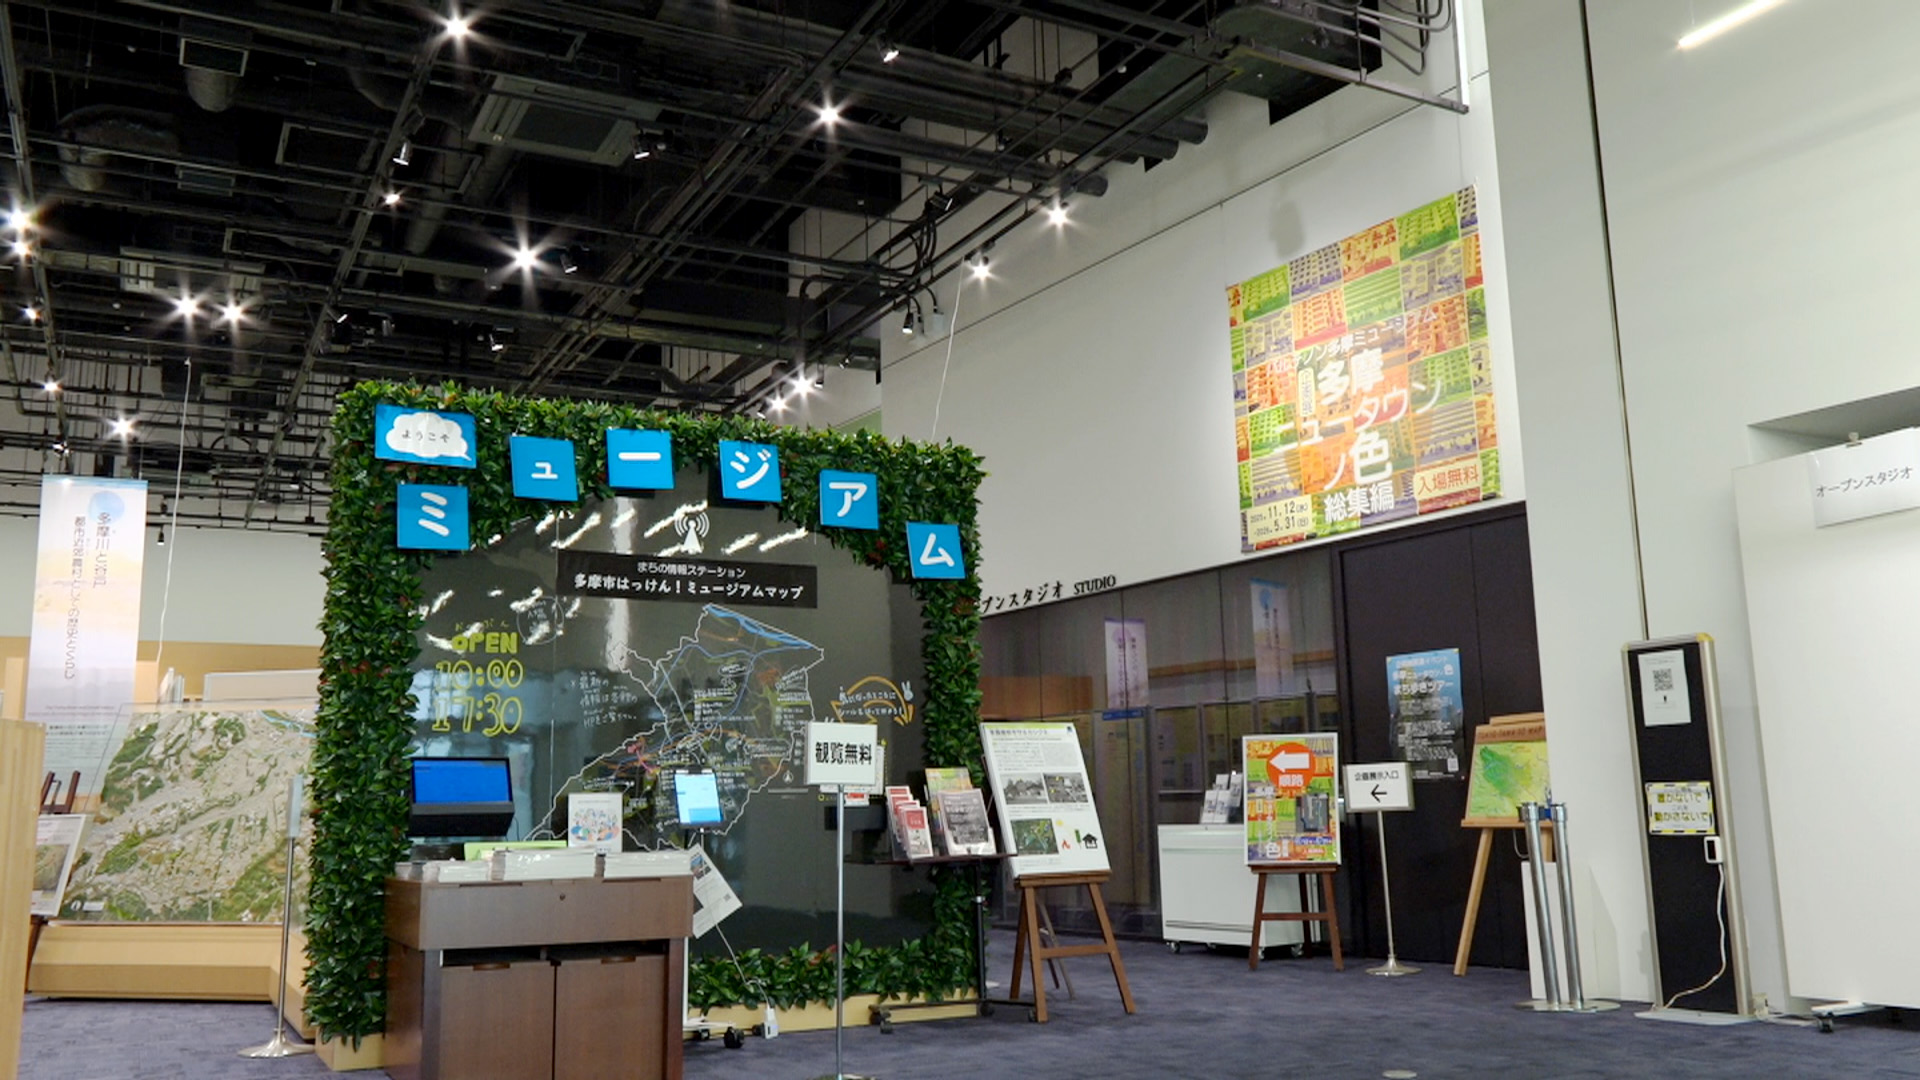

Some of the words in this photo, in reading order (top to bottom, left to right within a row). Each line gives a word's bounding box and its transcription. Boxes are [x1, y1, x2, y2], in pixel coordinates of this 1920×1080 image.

[1317, 348, 1385, 406] 多摩
[401, 428, 450, 444] ようこそ
[1417, 464, 1480, 497] 入場無料
[1816, 466, 1913, 498] オープンスタジオ
[1323, 480, 1395, 524] 総集編
[637, 561, 746, 578] まちの情報ステーション
[1073, 575, 1117, 596] STUDIO
[452, 632, 518, 654] OPEN
[435, 659, 524, 692] 10:00
[431, 692, 523, 738] 17:30
[815, 741, 872, 765] 観覧無料
